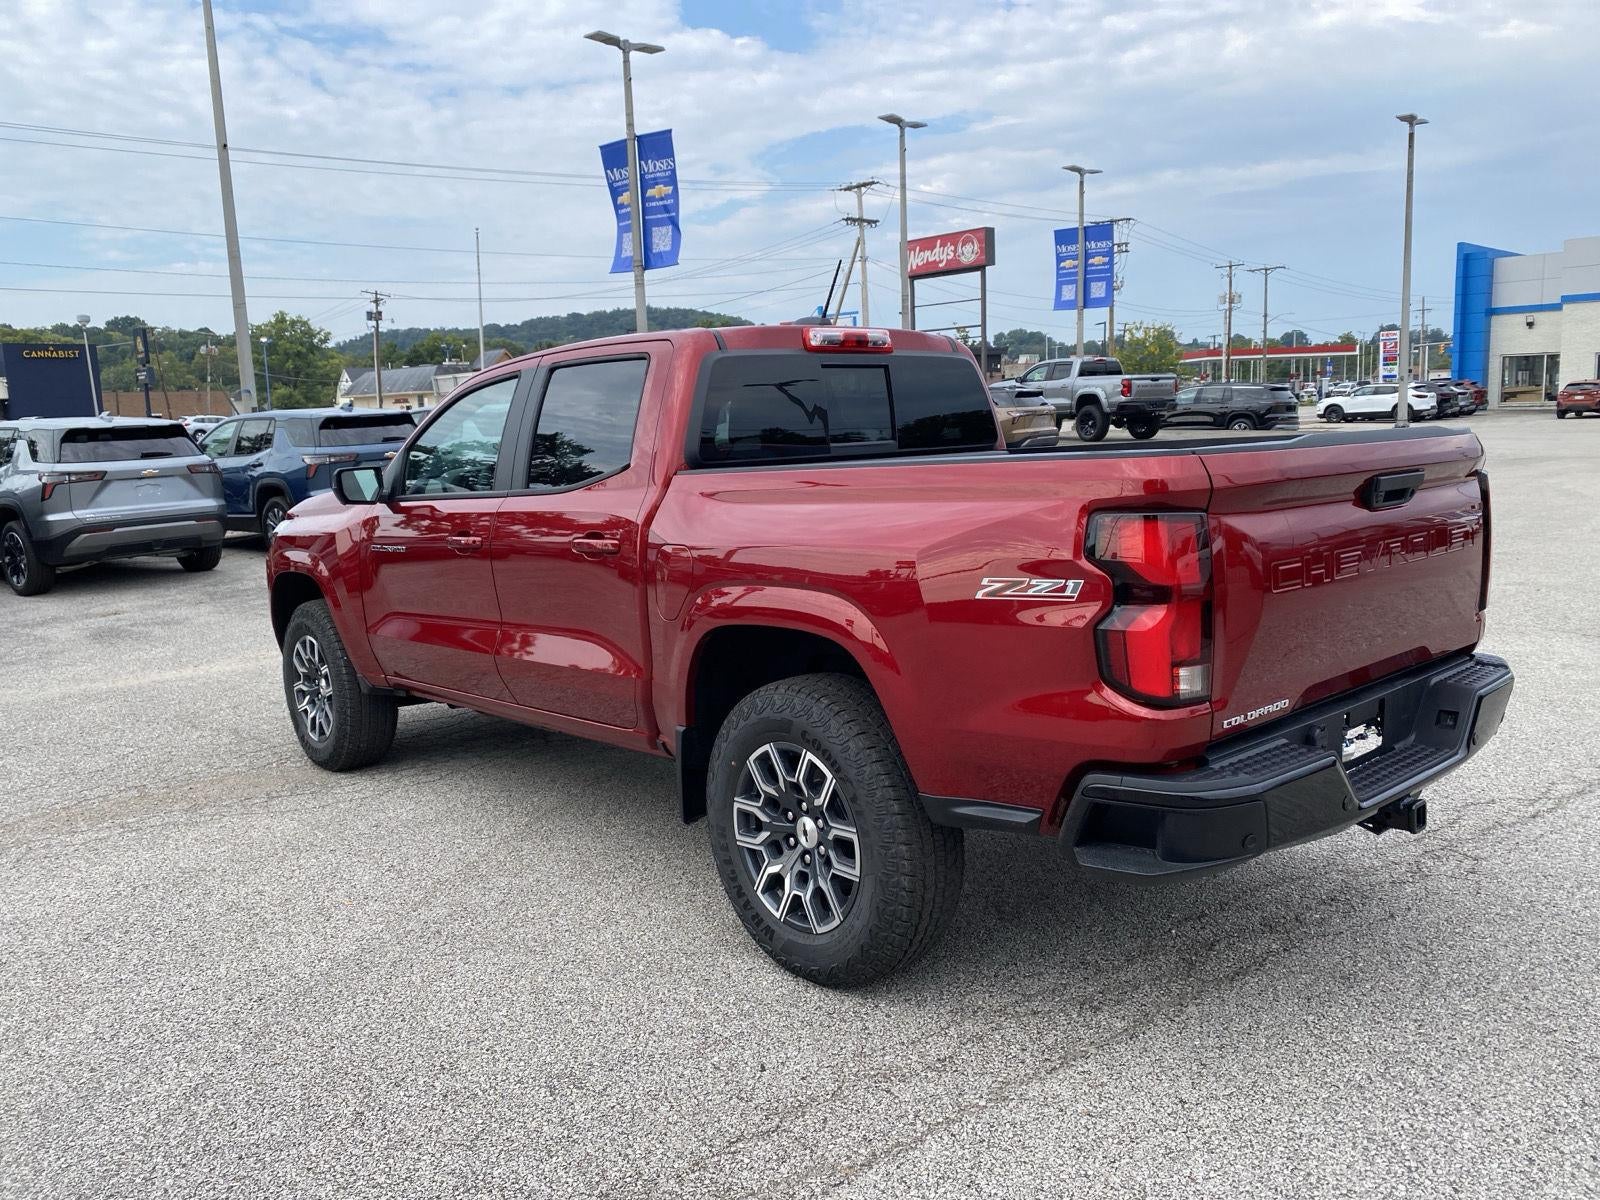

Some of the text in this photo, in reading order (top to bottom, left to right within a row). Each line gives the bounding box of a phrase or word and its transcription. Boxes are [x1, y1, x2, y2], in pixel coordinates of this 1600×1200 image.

[640, 158, 674, 173] MOSES
[606, 167, 630, 183] MOS
[1057, 245, 1079, 253] MOSE
[1086, 241, 1112, 250] MOSES
[907, 239, 955, 272] Wendy's
[22, 350, 80, 358] CANNABIST
[1270, 523, 1480, 595] CHEVROLET
[975, 577, 1085, 602] Z71
[1222, 698, 1290, 729] COLORADO
